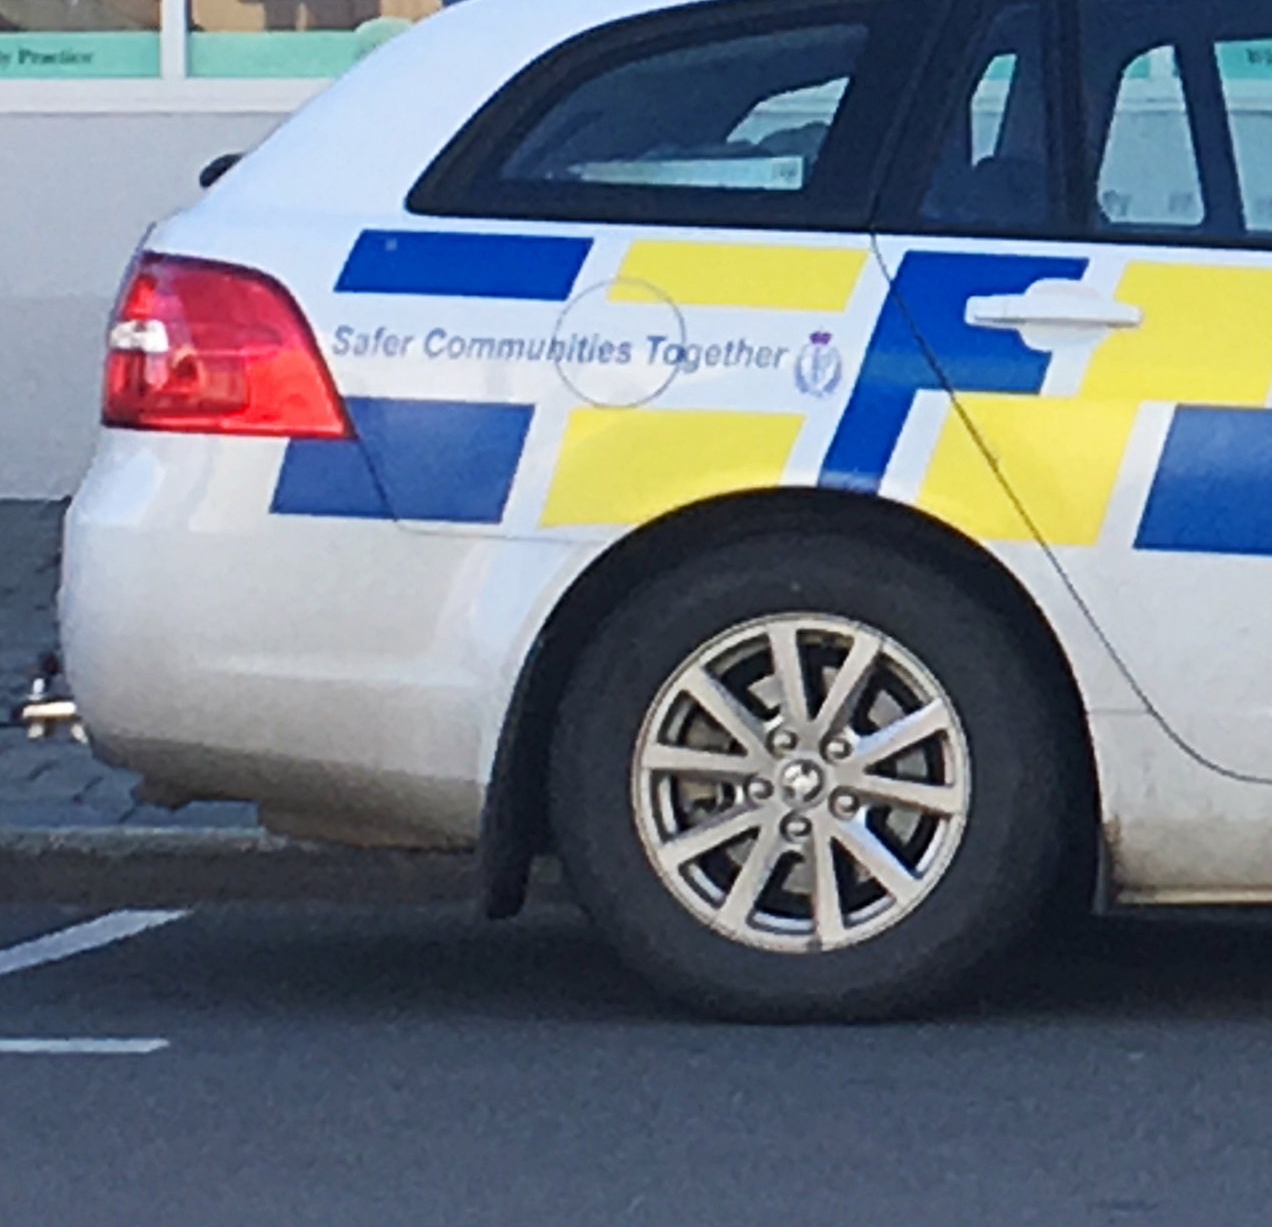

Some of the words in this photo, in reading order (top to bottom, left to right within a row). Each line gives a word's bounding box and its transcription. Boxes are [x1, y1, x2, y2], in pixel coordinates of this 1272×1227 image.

[333, 324, 415, 357] Safer
[423, 327, 633, 365] Communities
[645, 334, 790, 375] Together
